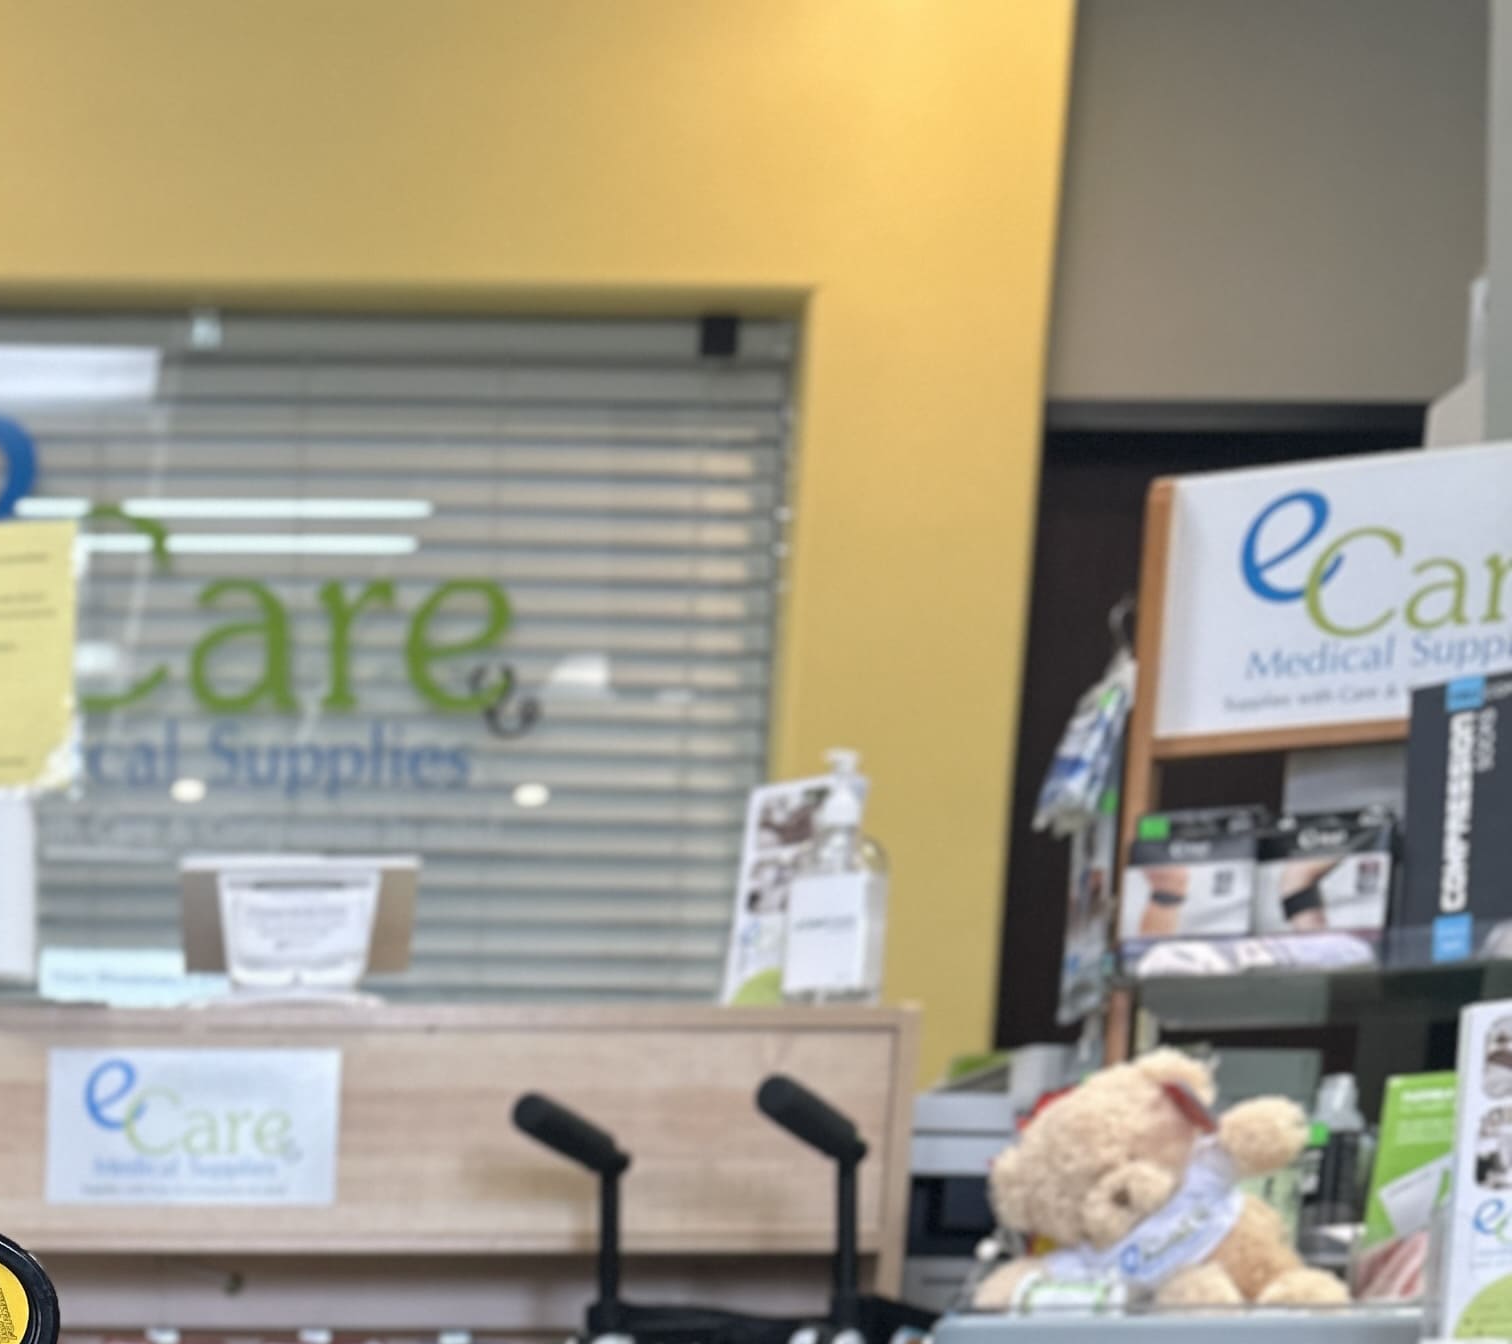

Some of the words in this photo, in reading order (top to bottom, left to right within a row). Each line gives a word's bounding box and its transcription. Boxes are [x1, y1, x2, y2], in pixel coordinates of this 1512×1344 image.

[1244, 634, 1396, 680] Medical
[204, 716, 471, 798] Supplies
[1438, 710, 1477, 914] COMPRESSION
[84, 1058, 293, 1159] eCare
